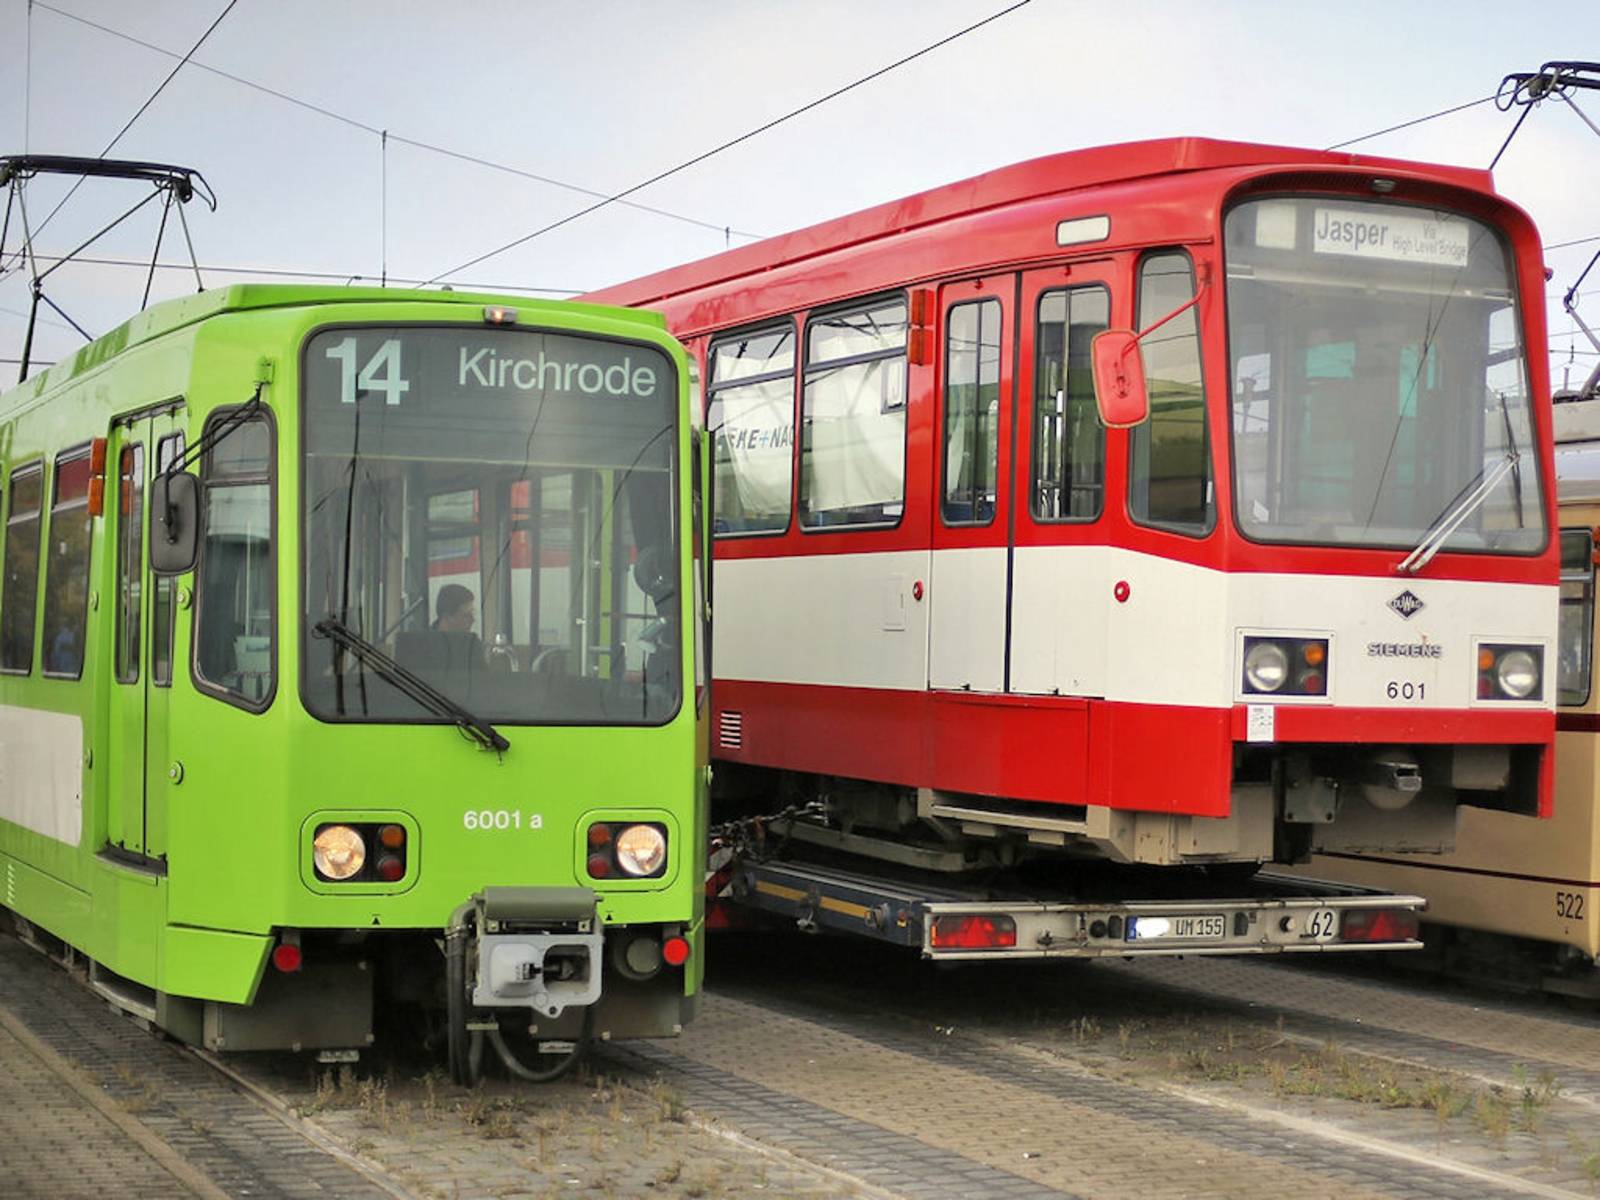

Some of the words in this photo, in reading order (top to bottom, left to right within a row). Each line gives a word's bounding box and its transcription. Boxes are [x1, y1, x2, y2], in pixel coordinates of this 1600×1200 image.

[1317, 211, 1389, 250] Jasper
[325, 336, 410, 406] 14
[458, 346, 657, 398] Kirchrode
[1367, 641, 1442, 659] SIEMENS
[1386, 680, 1425, 700] 601
[463, 809, 521, 830] 6001
[529, 813, 543, 830] a
[1555, 891, 1585, 921] 522
[1311, 911, 1333, 938] 62
